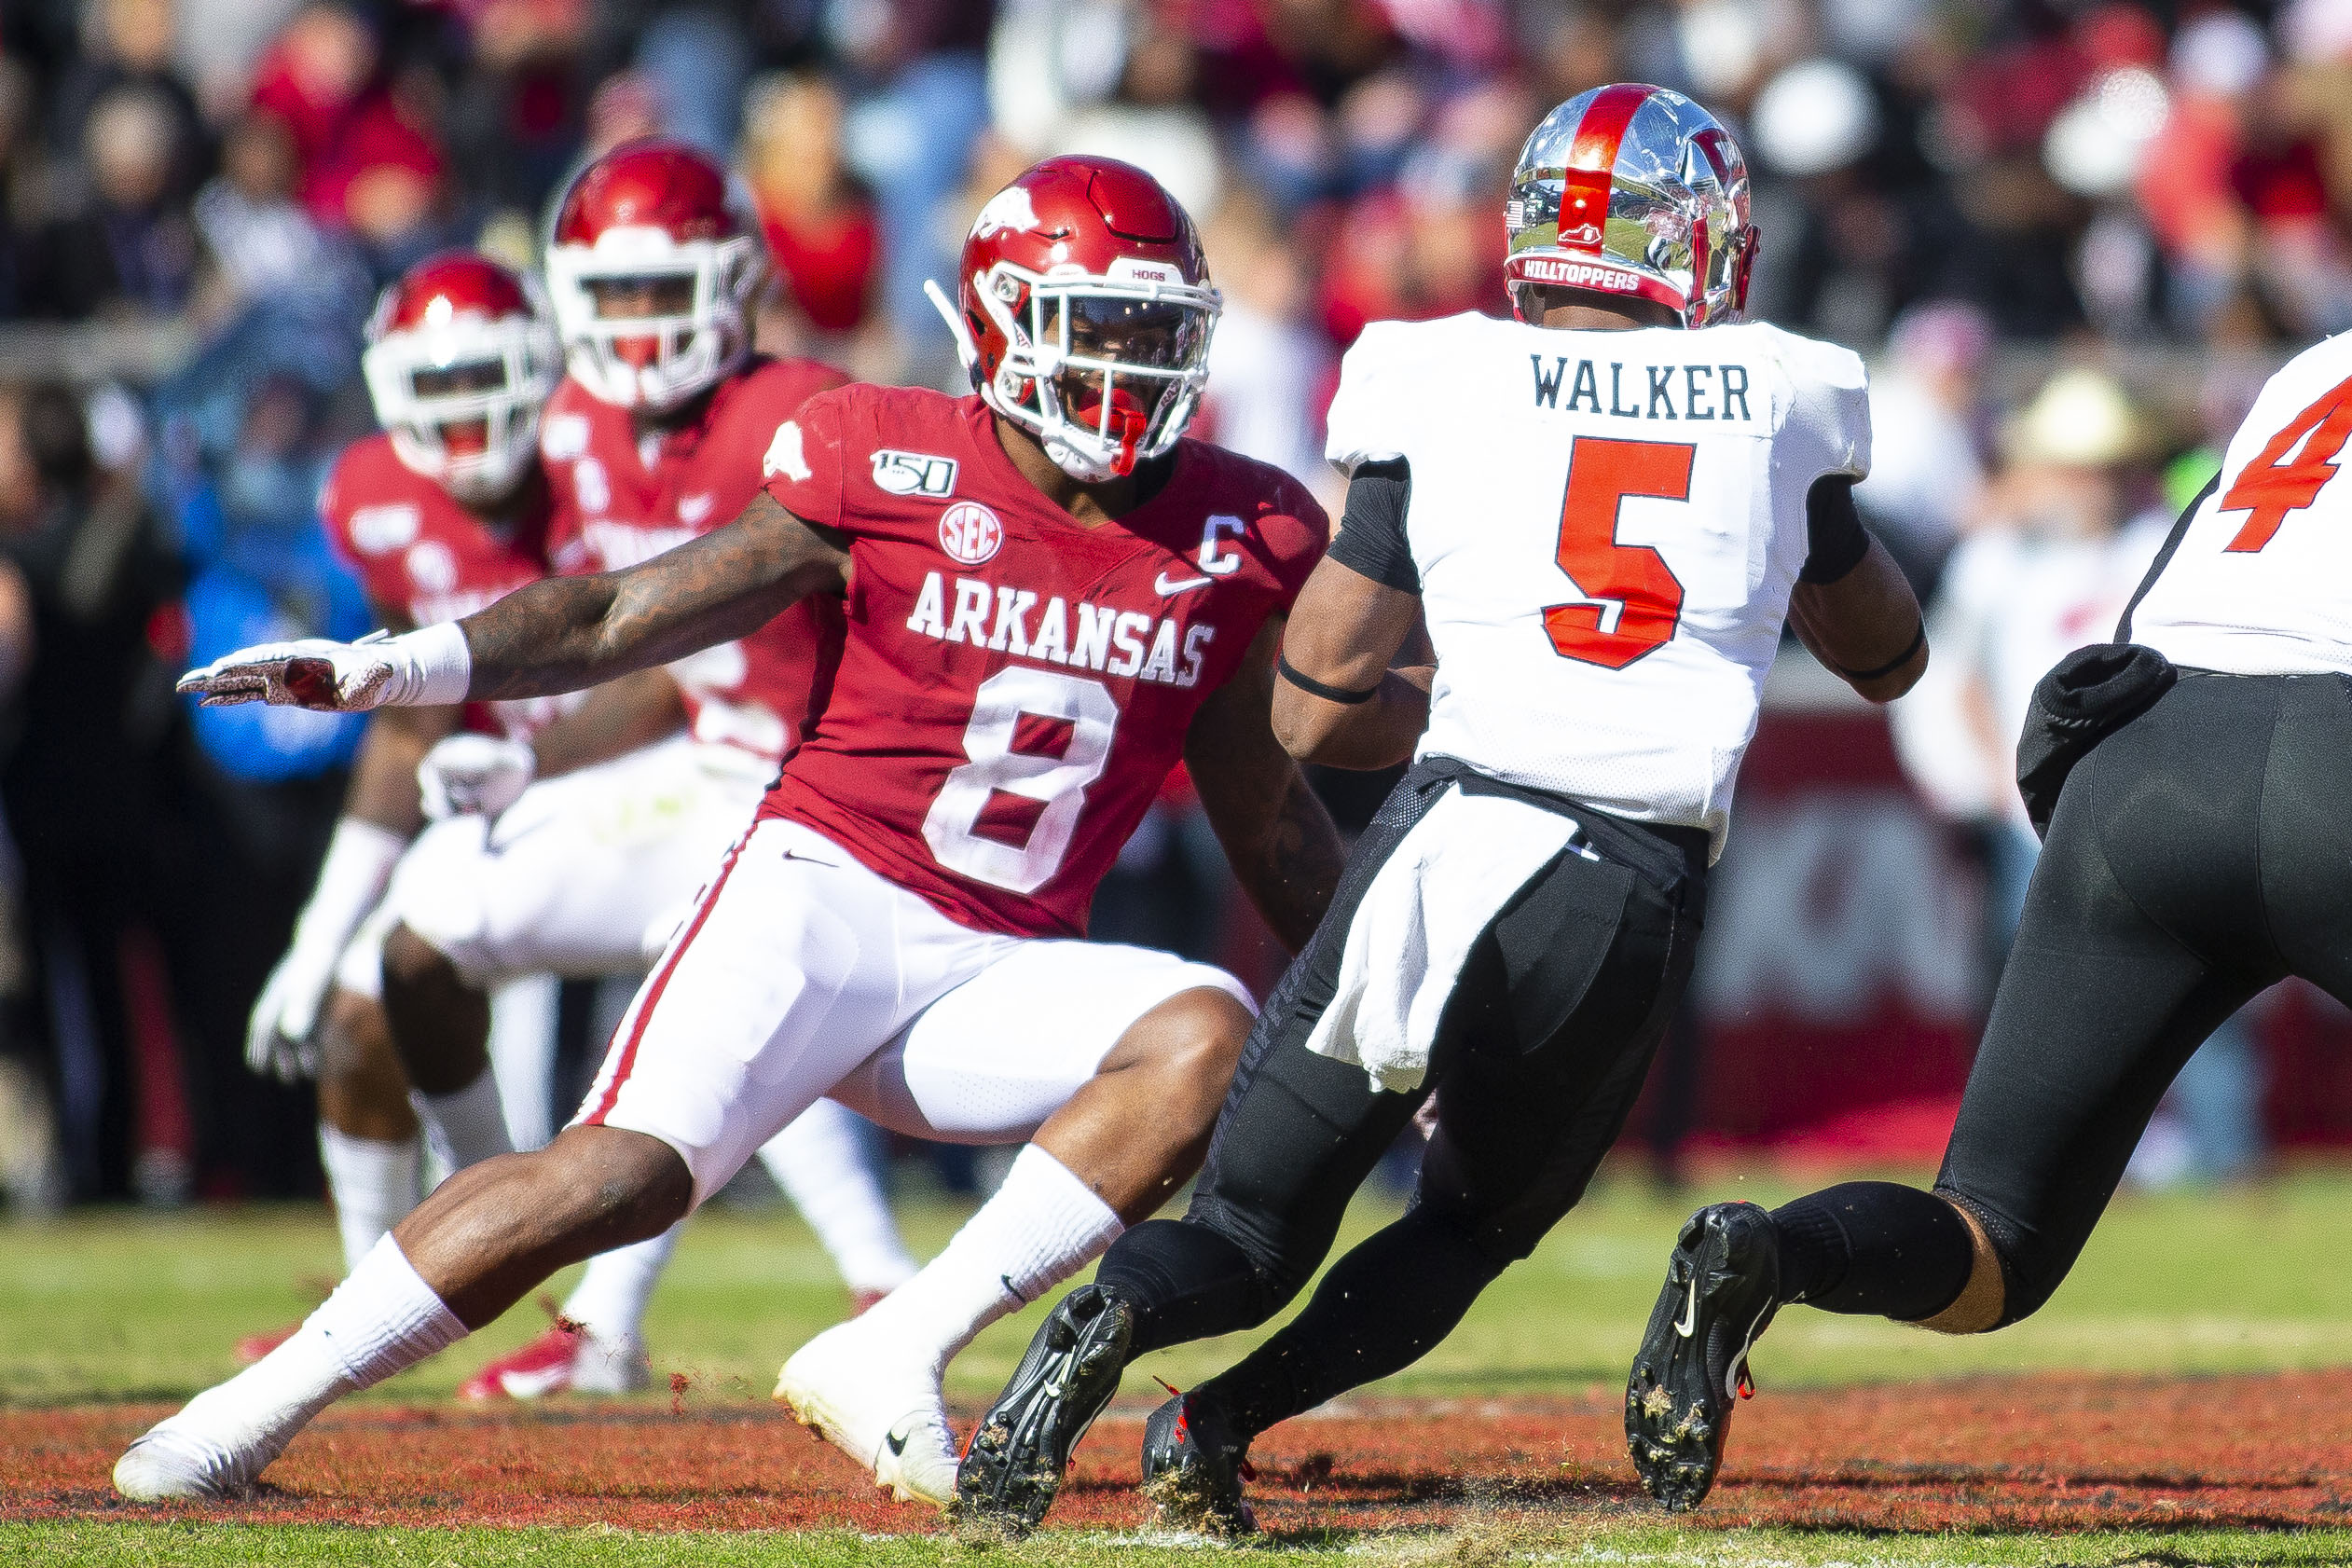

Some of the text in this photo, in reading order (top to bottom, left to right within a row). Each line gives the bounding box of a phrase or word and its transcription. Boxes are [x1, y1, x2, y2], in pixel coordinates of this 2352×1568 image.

[1132, 269, 1165, 282] HOGS
[1524, 260, 1641, 290] HILLTOPPERS
[1530, 353, 1751, 420] WALKER
[879, 453, 954, 493] 150
[2217, 374, 2352, 553] 4
[945, 504, 998, 559] SEC
[1198, 514, 1245, 574] C
[1540, 434, 1698, 670] 5
[906, 571, 1215, 688] ARKANSAS
[920, 665, 1121, 895] 8
